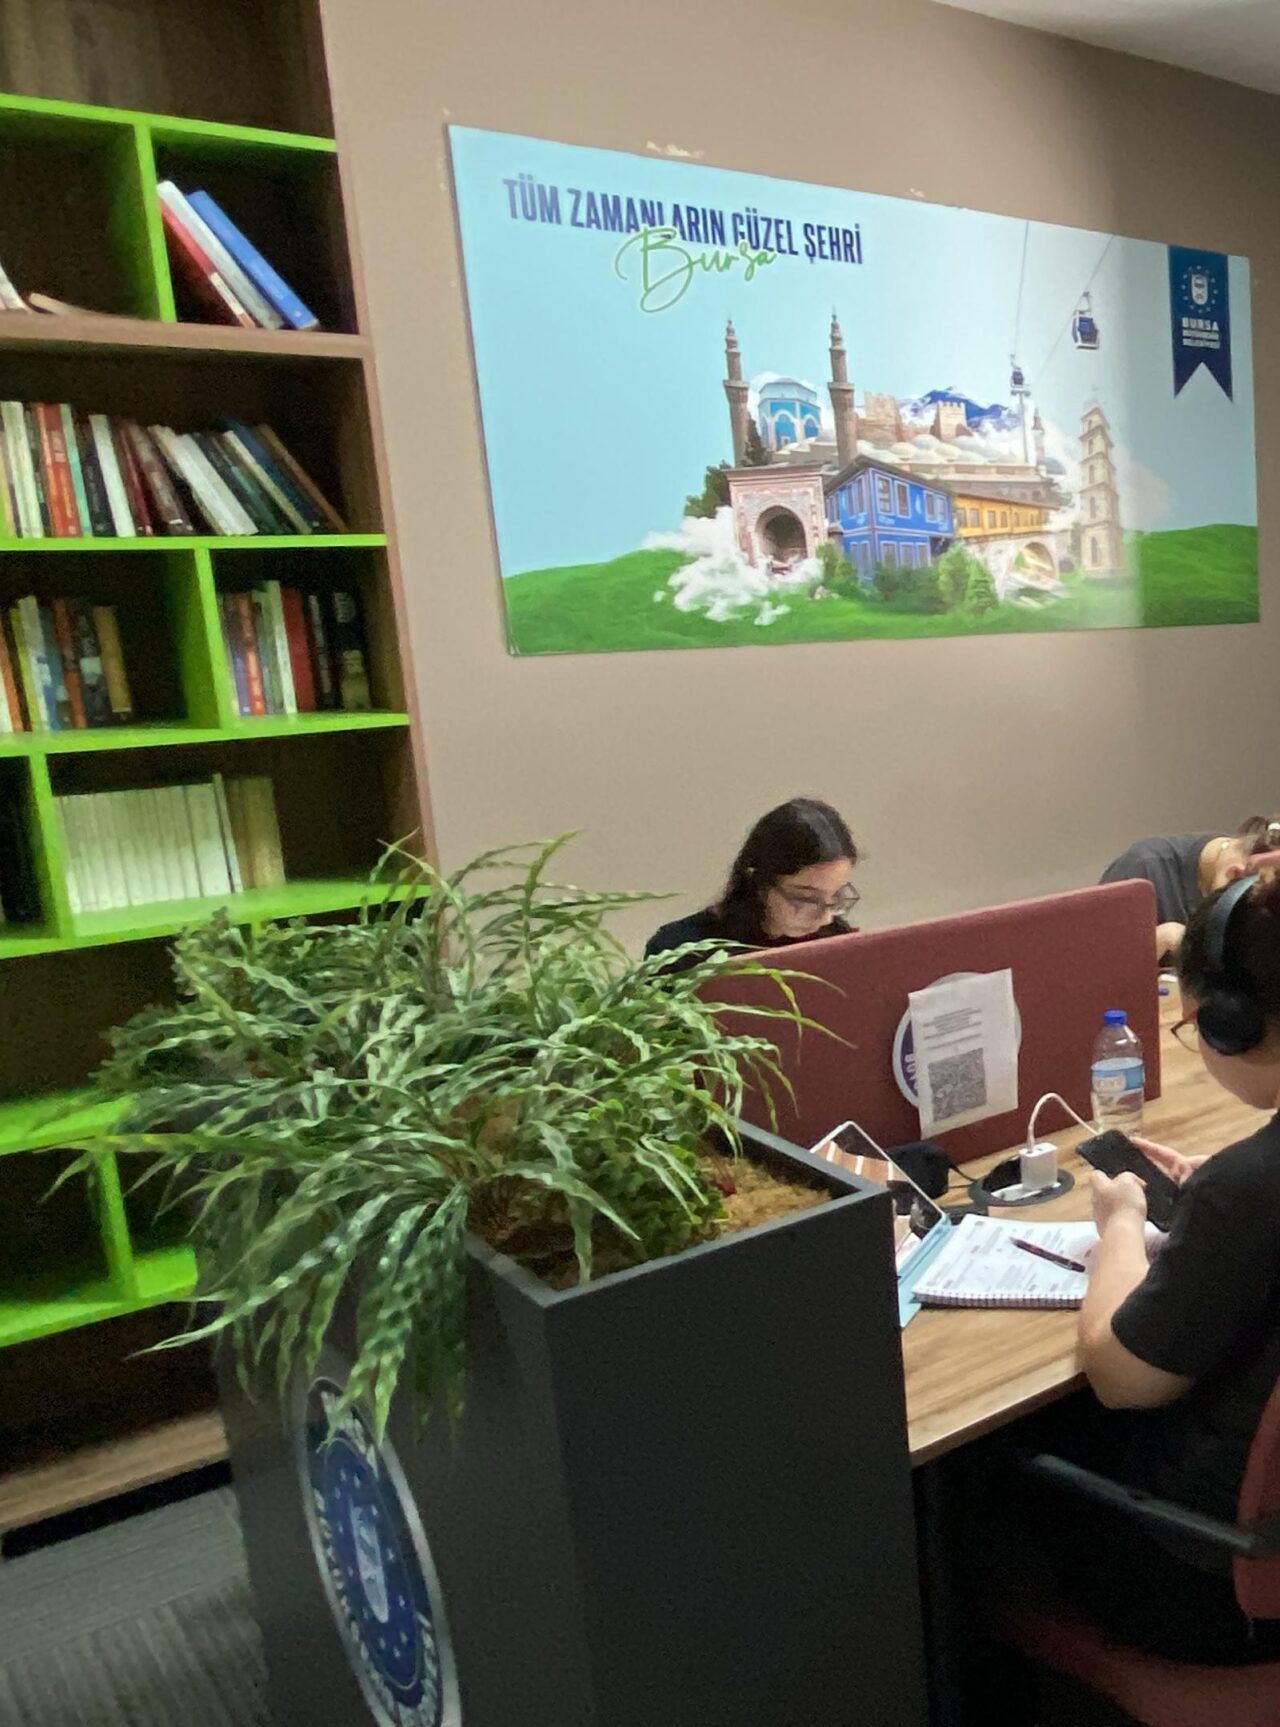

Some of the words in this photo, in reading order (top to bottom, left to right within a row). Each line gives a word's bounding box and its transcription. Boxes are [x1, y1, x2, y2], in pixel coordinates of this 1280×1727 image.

[502, 173, 562, 225] TÜM
[732, 207, 799, 256] GÜZEL
[804, 222, 864, 266] ŞEHRİ
[615, 226, 778, 314] Bursa
